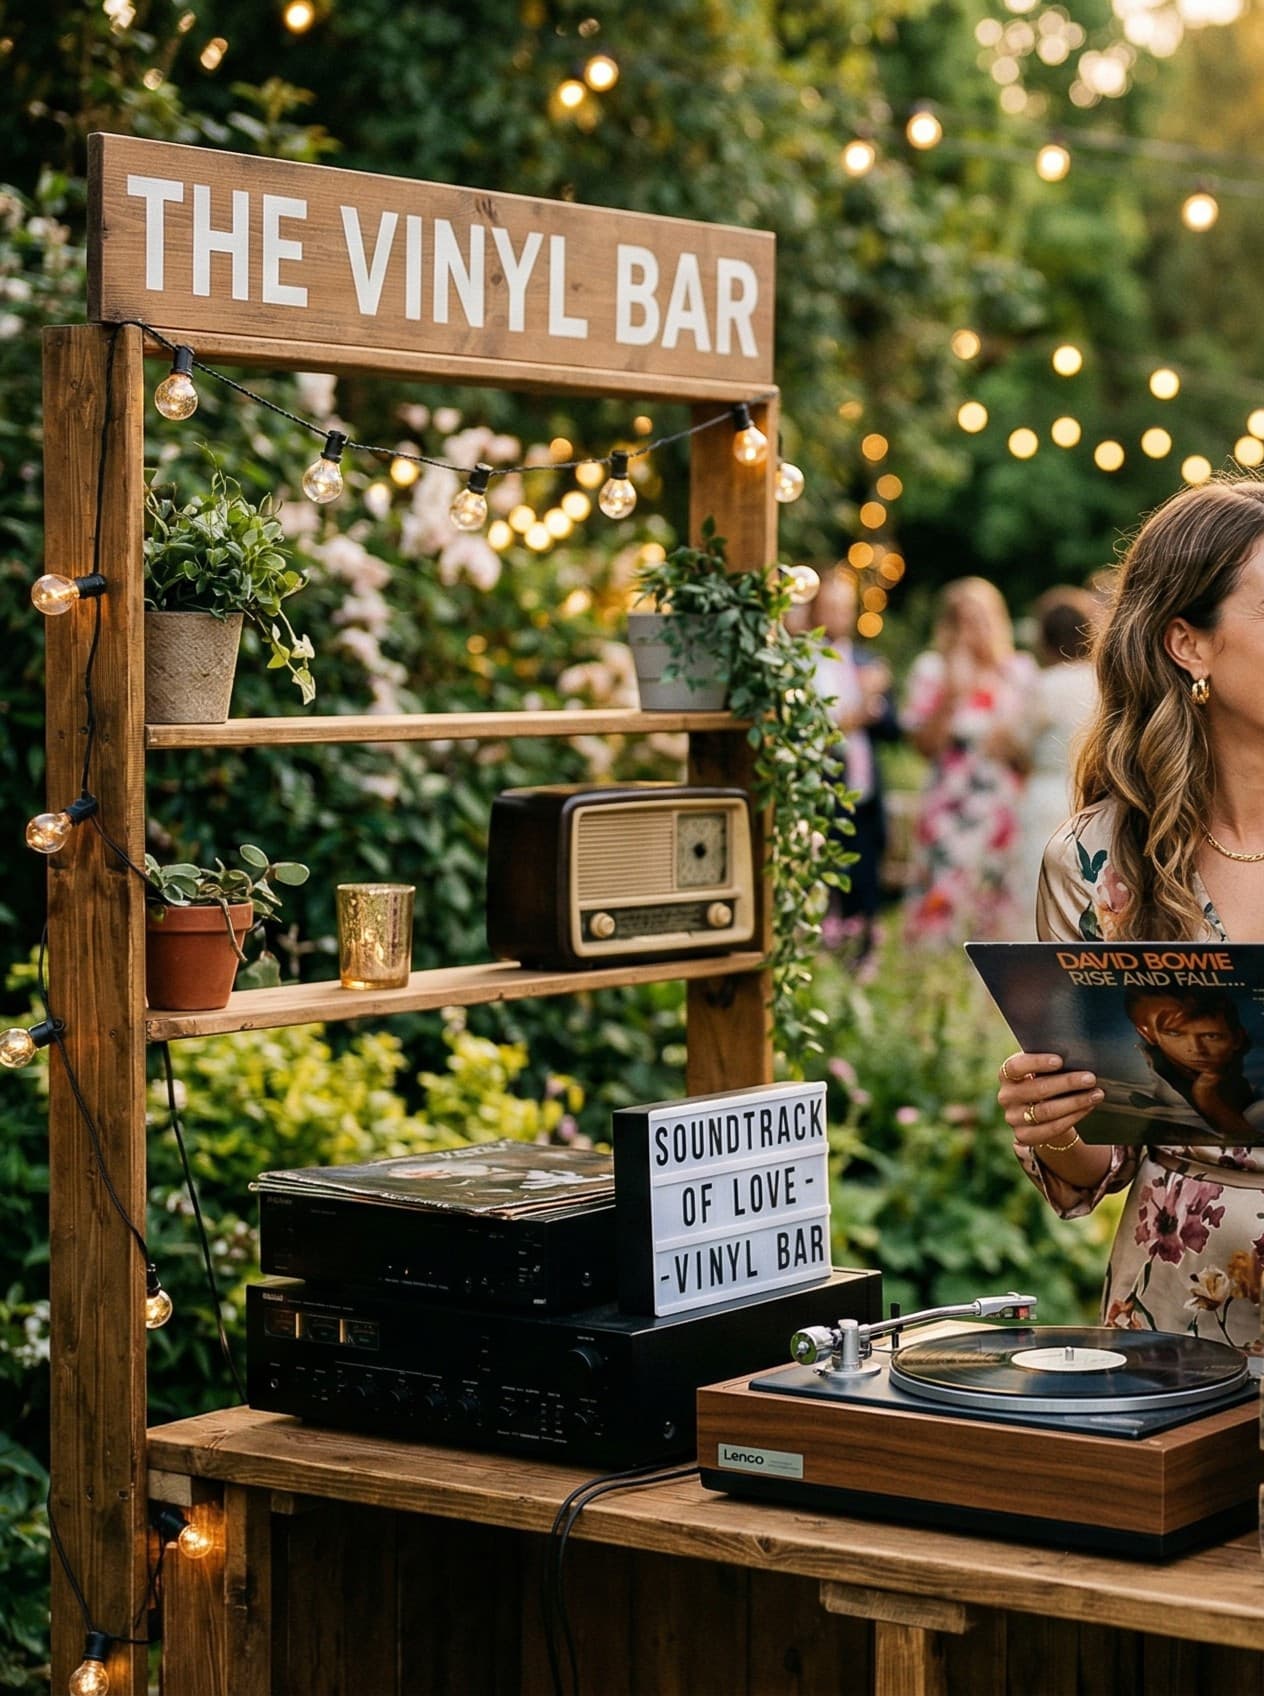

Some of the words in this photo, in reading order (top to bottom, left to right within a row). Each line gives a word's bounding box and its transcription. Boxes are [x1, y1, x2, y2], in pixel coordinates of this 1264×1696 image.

[127, 174, 308, 308] THE
[340, 205, 588, 339] VINYL
[616, 243, 759, 358] BAR
[1056, 952, 1138, 970] DAVID
[1143, 952, 1234, 970] BOWIE
[1068, 971, 1118, 986] RISE
[1123, 971, 1170, 987] AND
[655, 1098, 823, 1166] SOUNDTRACK
[682, 1183, 713, 1227] OF
[777, 1224, 824, 1271] BAR
[723, 1448, 764, 1465] Lenco
